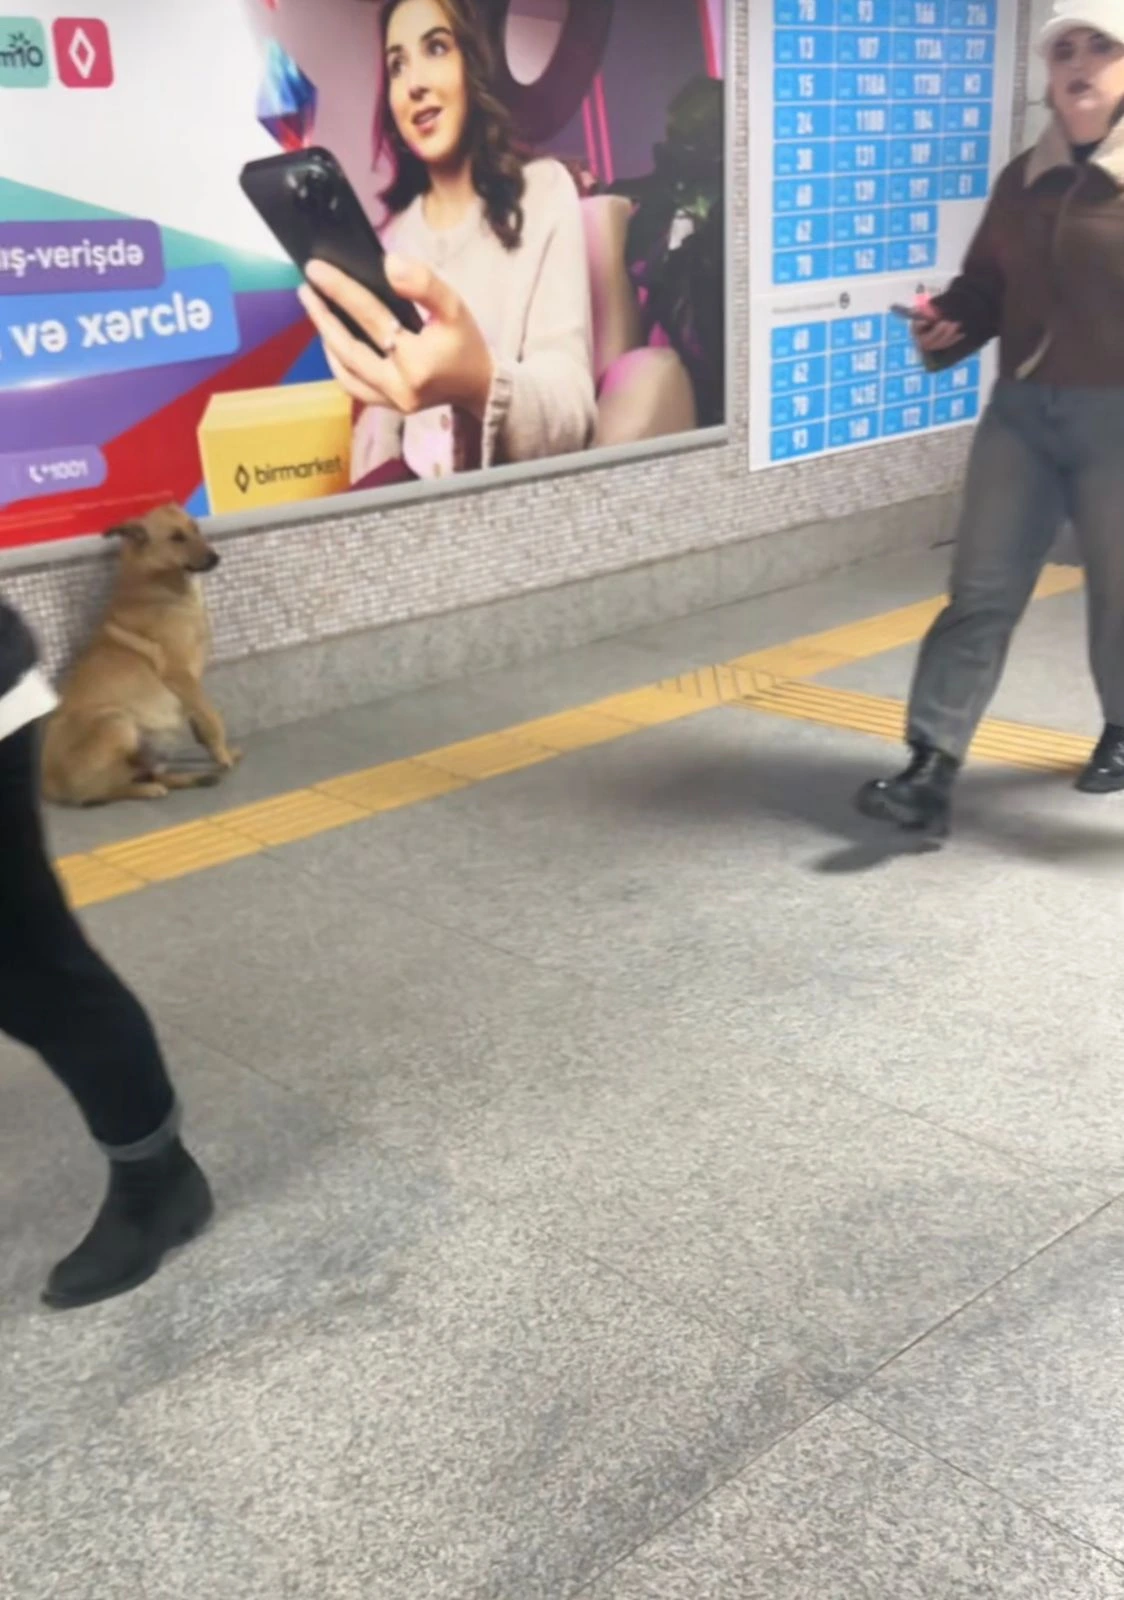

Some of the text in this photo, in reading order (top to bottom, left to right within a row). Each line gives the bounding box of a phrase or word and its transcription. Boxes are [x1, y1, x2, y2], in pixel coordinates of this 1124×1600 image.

[798, 73, 815, 98] 15
[9, 291, 212, 357] və xərclə
[254, 455, 341, 485] birmarket
